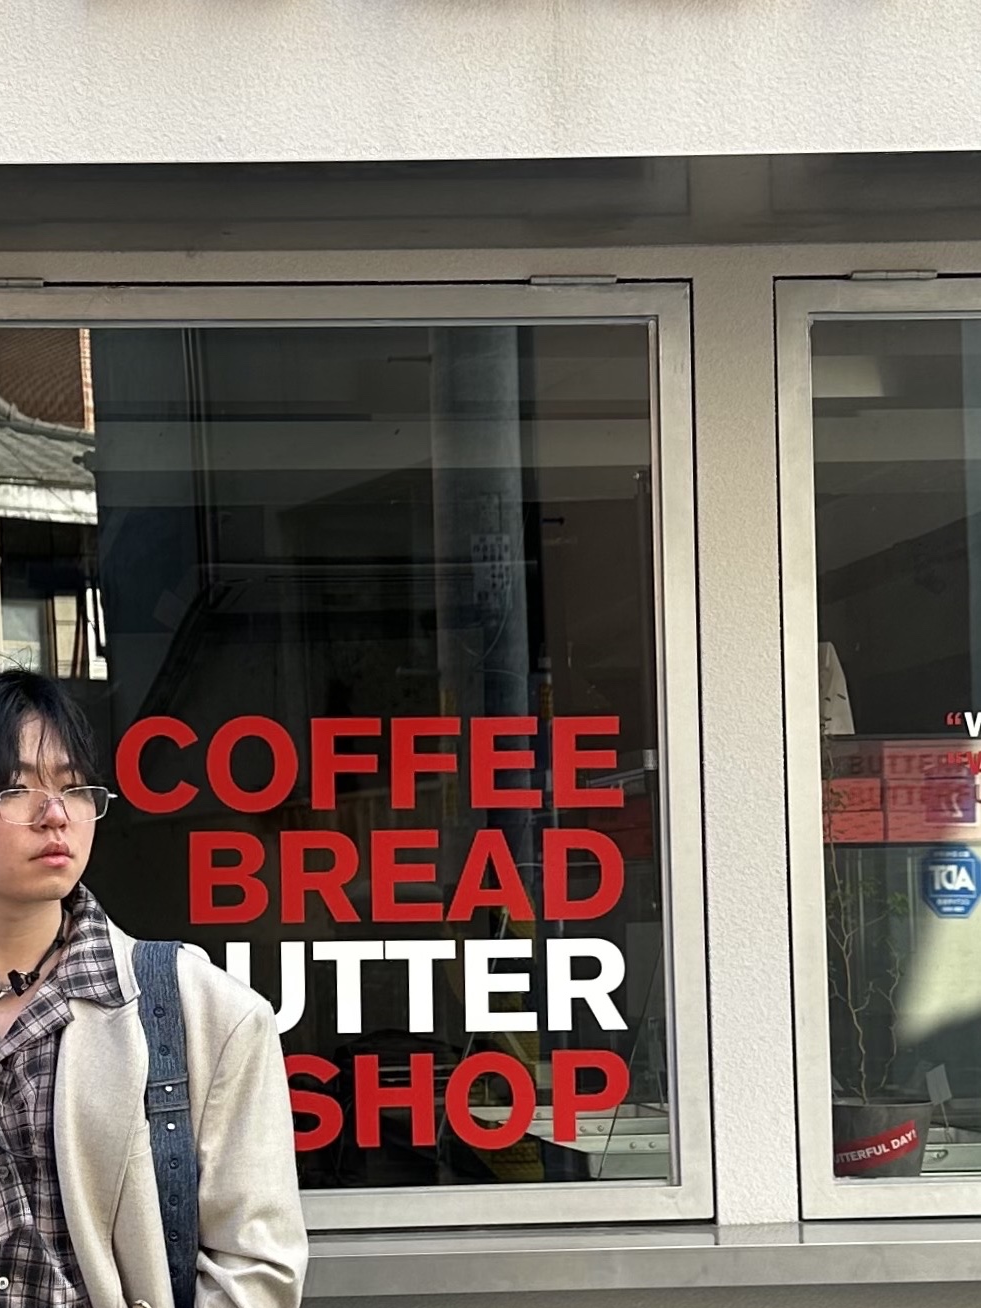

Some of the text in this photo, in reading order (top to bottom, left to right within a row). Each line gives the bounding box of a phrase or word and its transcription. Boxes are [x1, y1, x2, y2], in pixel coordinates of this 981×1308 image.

[115, 716, 625, 813] COFFEE
[188, 828, 625, 924] BREAD
[183, 939, 627, 1034] UTTER
[284, 1049, 630, 1152] SHOP
[891, 1129, 917, 1150] DAY!
